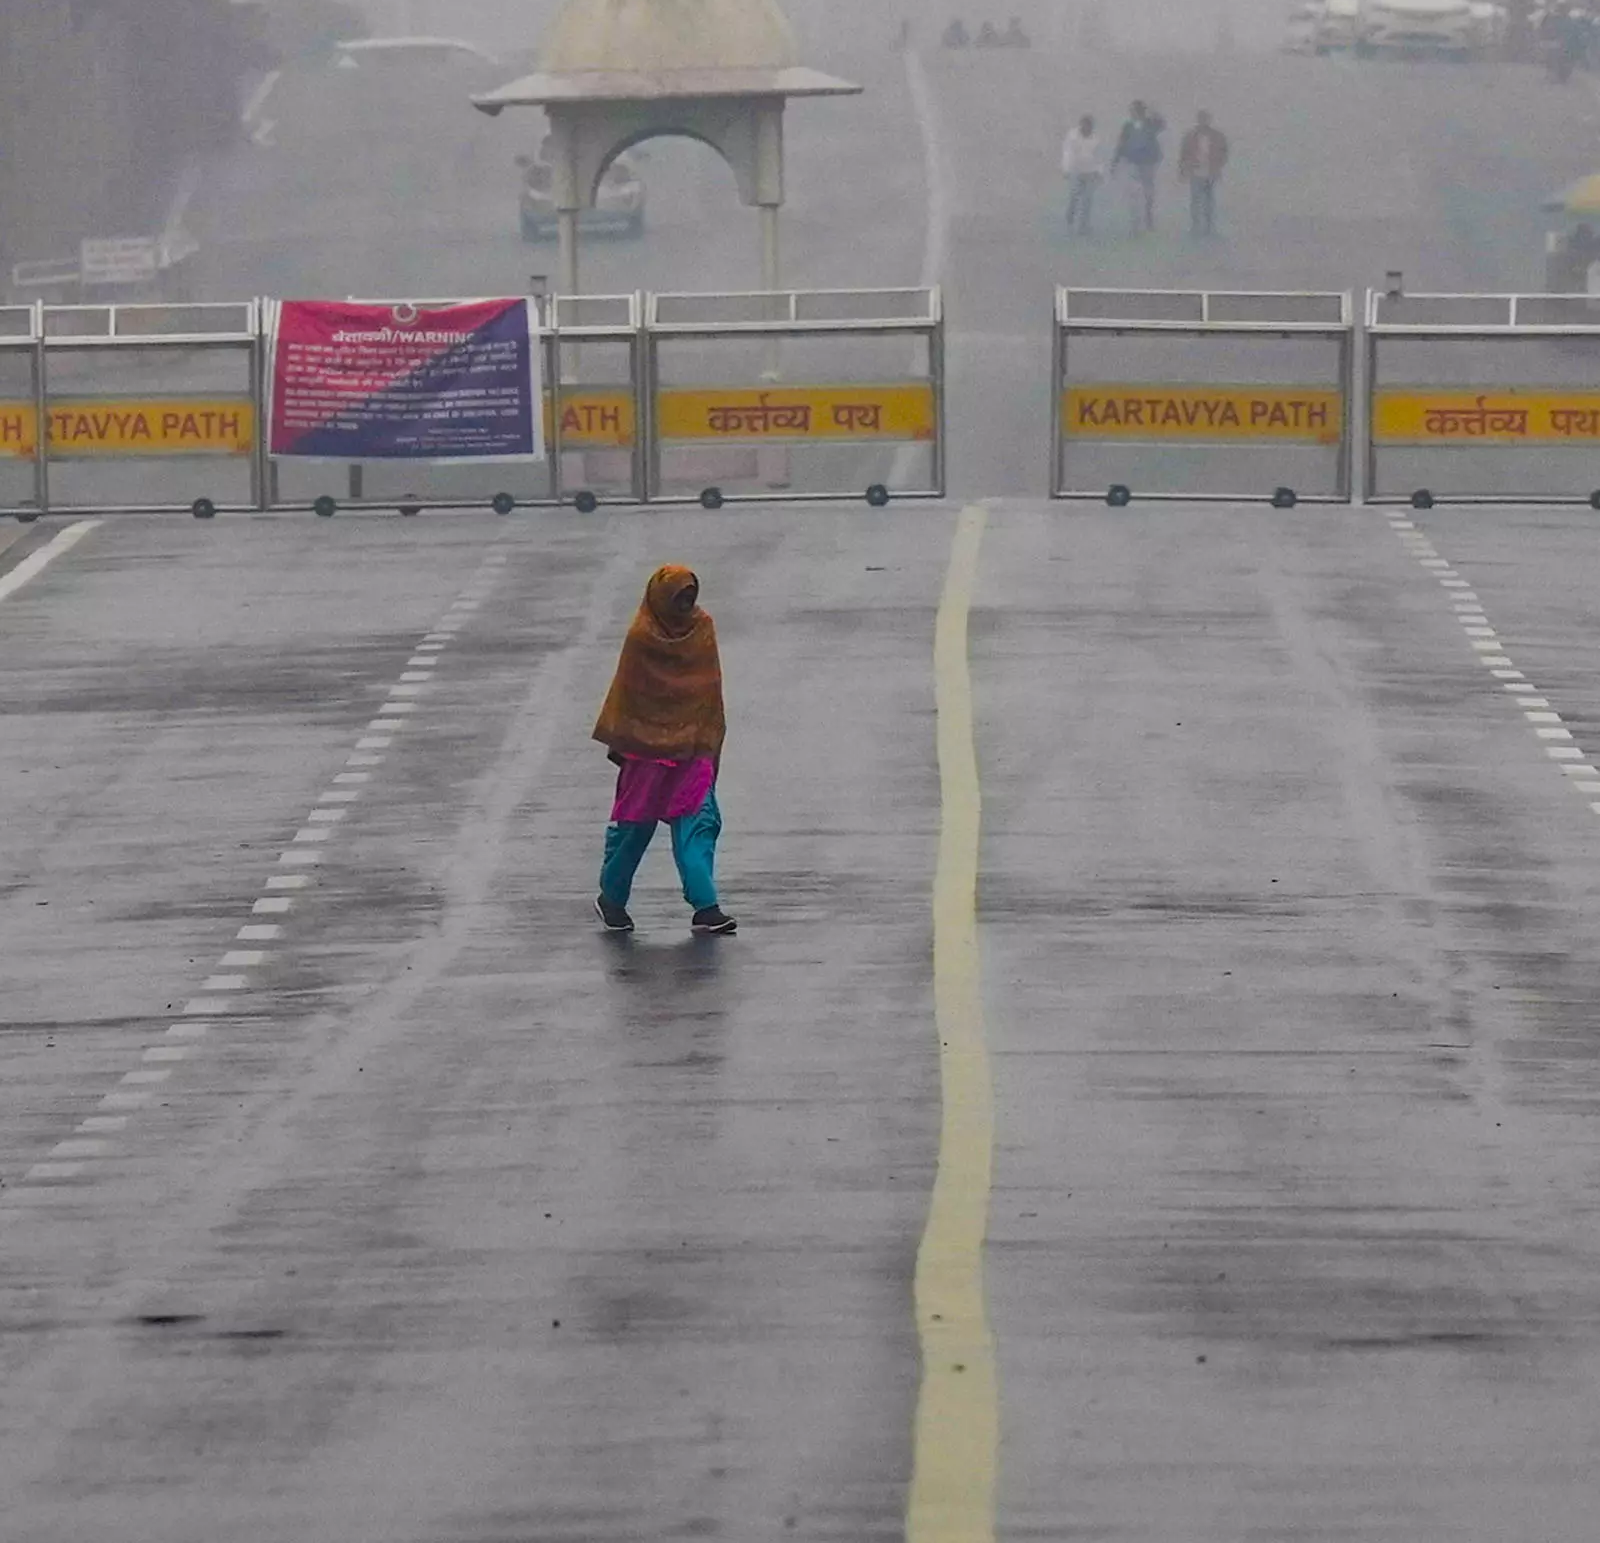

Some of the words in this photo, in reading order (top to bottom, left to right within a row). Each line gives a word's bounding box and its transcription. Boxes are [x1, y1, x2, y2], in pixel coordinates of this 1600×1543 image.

[161, 411, 240, 439] PATH
[559, 405, 620, 432] ATH
[831, 404, 883, 431] पथ
[1078, 398, 1240, 427] KARTAVYA
[1250, 401, 1327, 427] PATH
